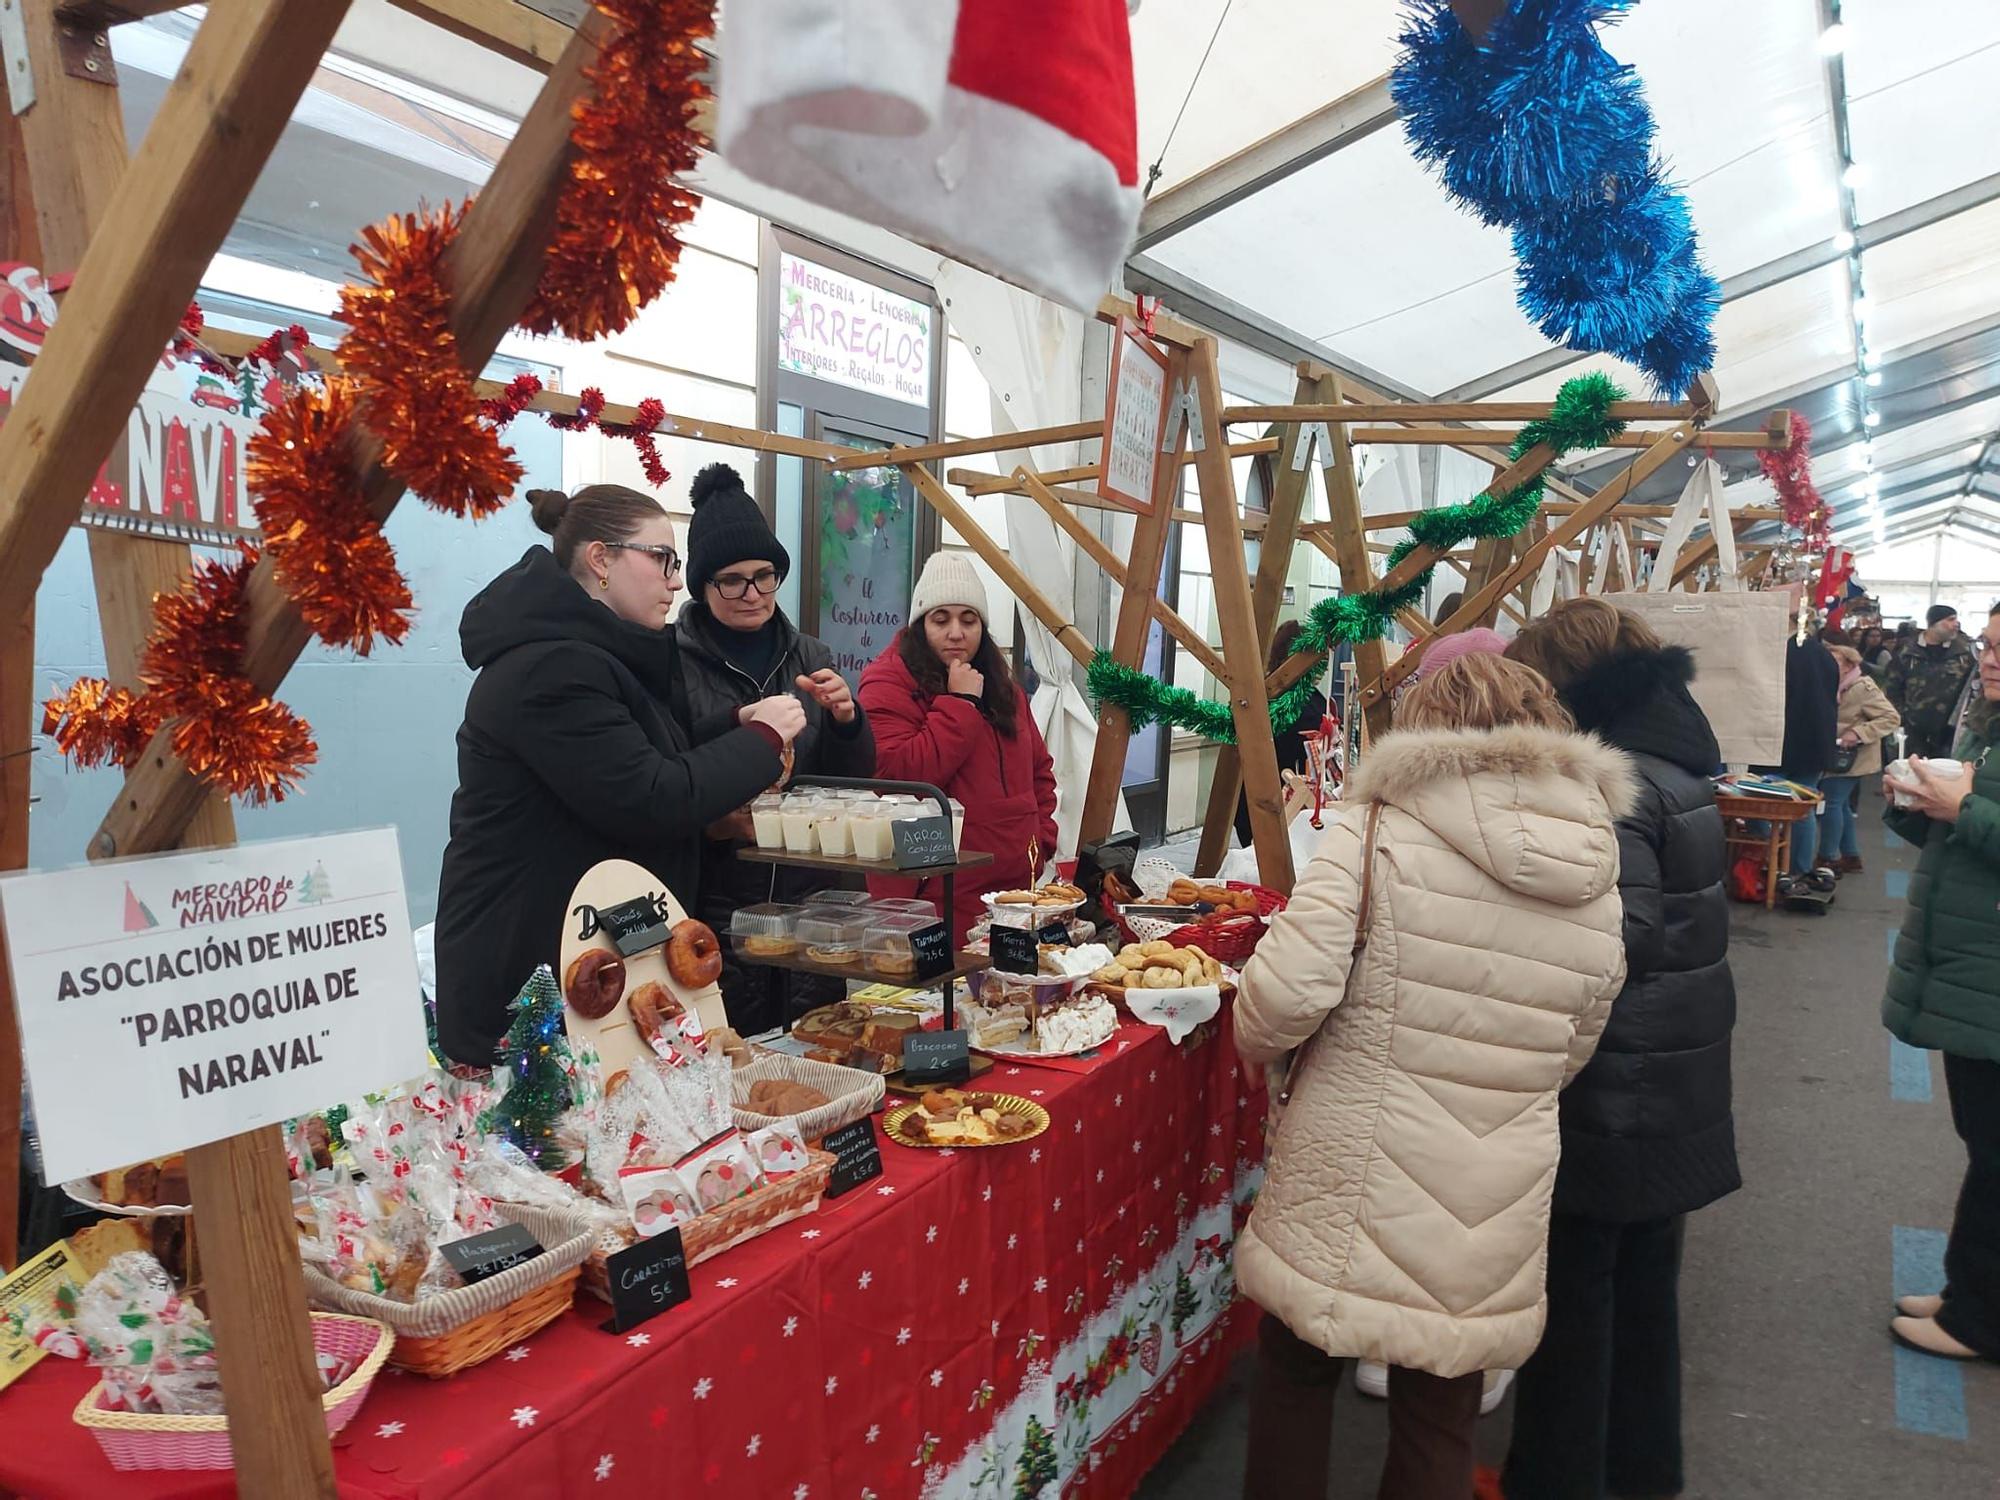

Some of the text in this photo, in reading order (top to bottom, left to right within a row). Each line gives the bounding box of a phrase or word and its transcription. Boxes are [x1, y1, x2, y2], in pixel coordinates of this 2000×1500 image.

[786, 295, 924, 374] ARREGLOS
[848, 359, 885, 385] REGALOS
[895, 373, 923, 397] HOGAR
[861, 577, 873, 599] El
[831, 605, 900, 626] Costurero
[860, 629, 872, 648] de
[172, 875, 294, 909] MERCADO de
[180, 890, 288, 928] NAVIDAD
[58, 912, 387, 1001] ASOCIACIÓN DE MUJERES
[325, 968, 359, 1003] DE
[650, 1283, 673, 1304] 5€
